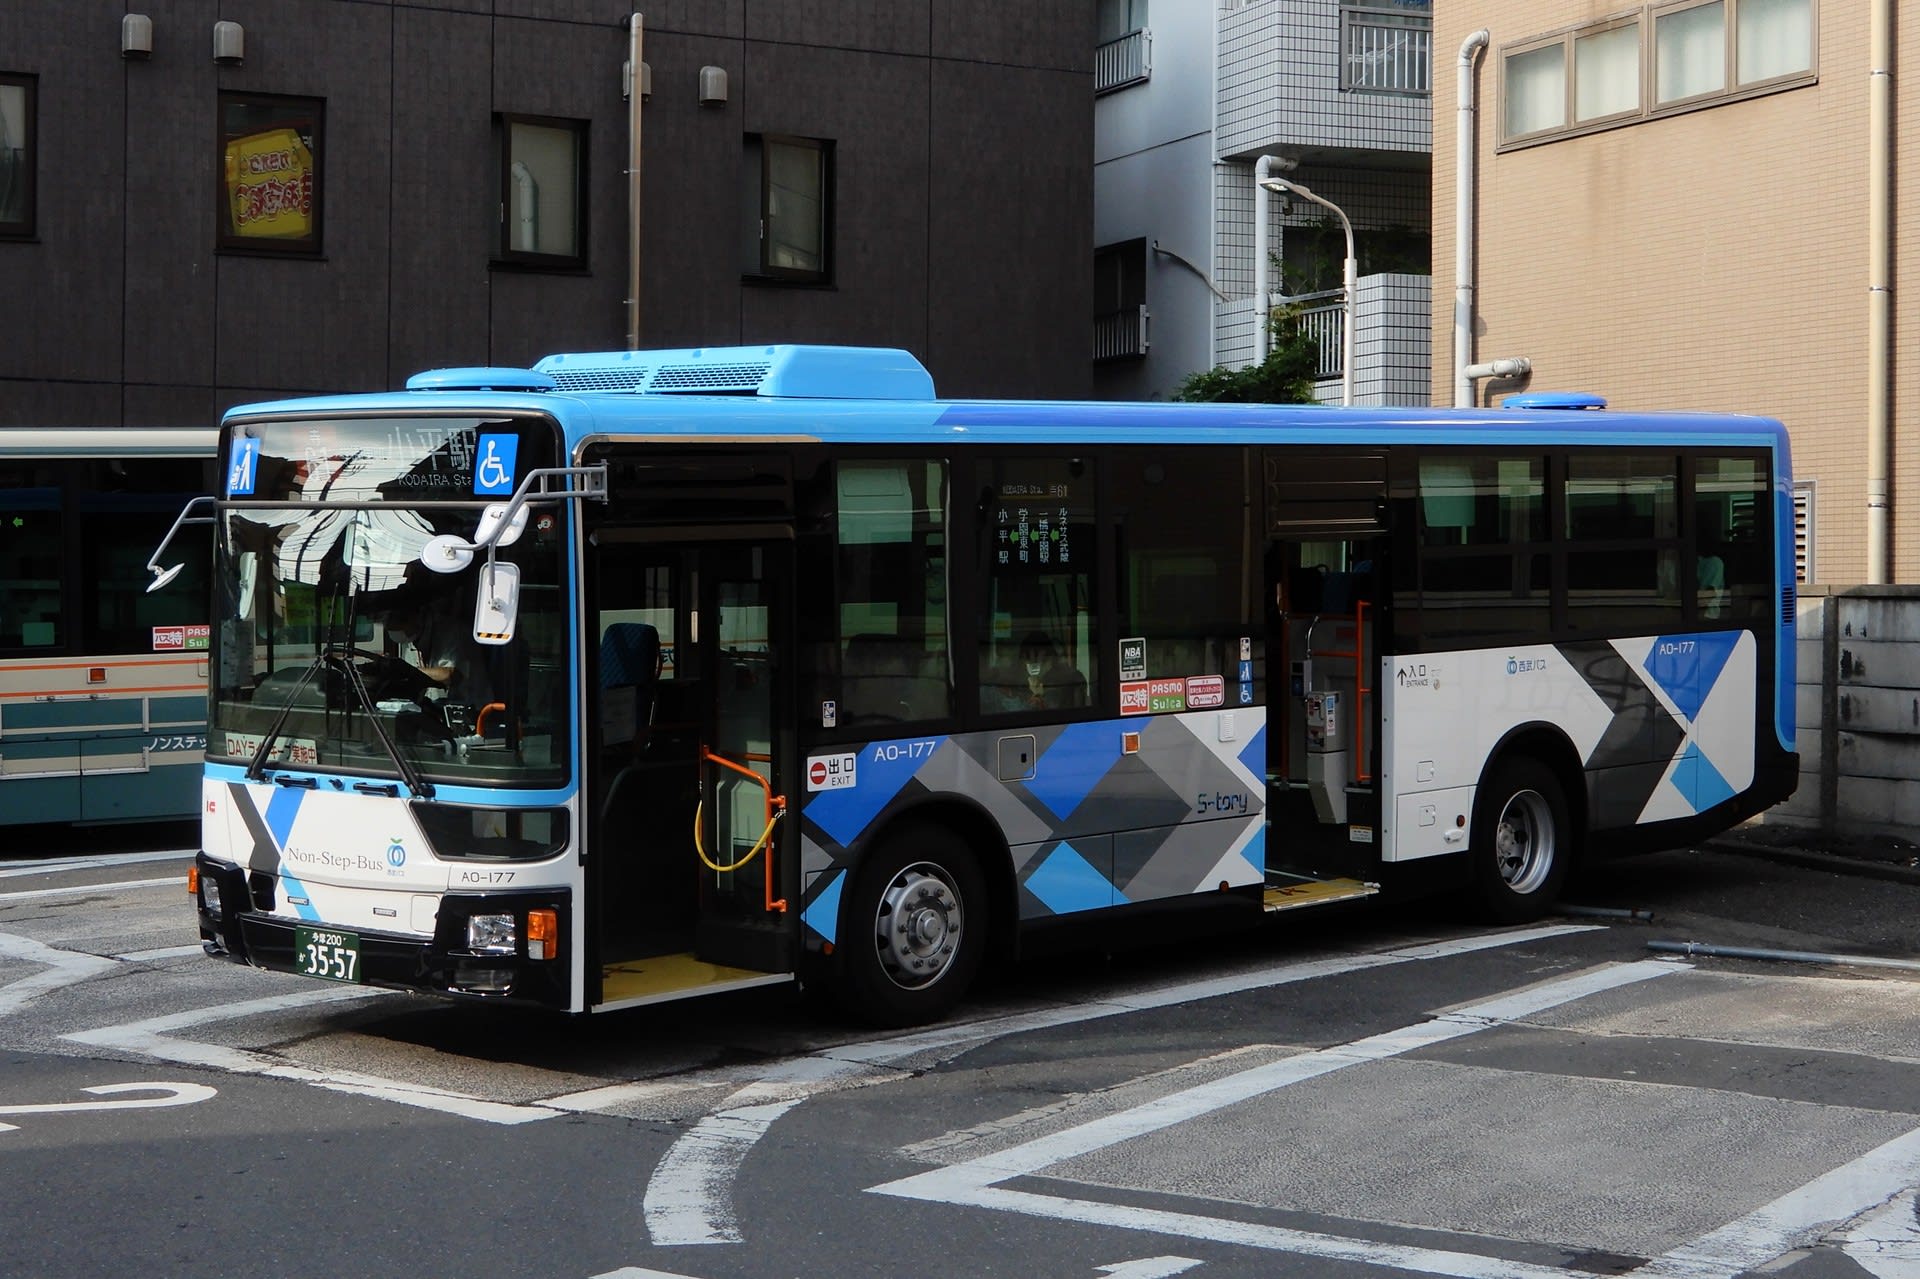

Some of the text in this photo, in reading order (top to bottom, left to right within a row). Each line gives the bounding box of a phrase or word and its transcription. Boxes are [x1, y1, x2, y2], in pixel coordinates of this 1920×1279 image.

[187, 628, 209, 636] PAS
[1124, 646, 1141, 658] NBA
[1408, 664, 1426, 678] 入口
[1151, 681, 1183, 695] PASMO
[1152, 697, 1182, 710] Suica
[828, 757, 854, 775] 出口
[831, 775, 851, 786] EXIT
[288, 847, 384, 871] Non-Step-Bus
[305, 943, 358, 980] 35-57
